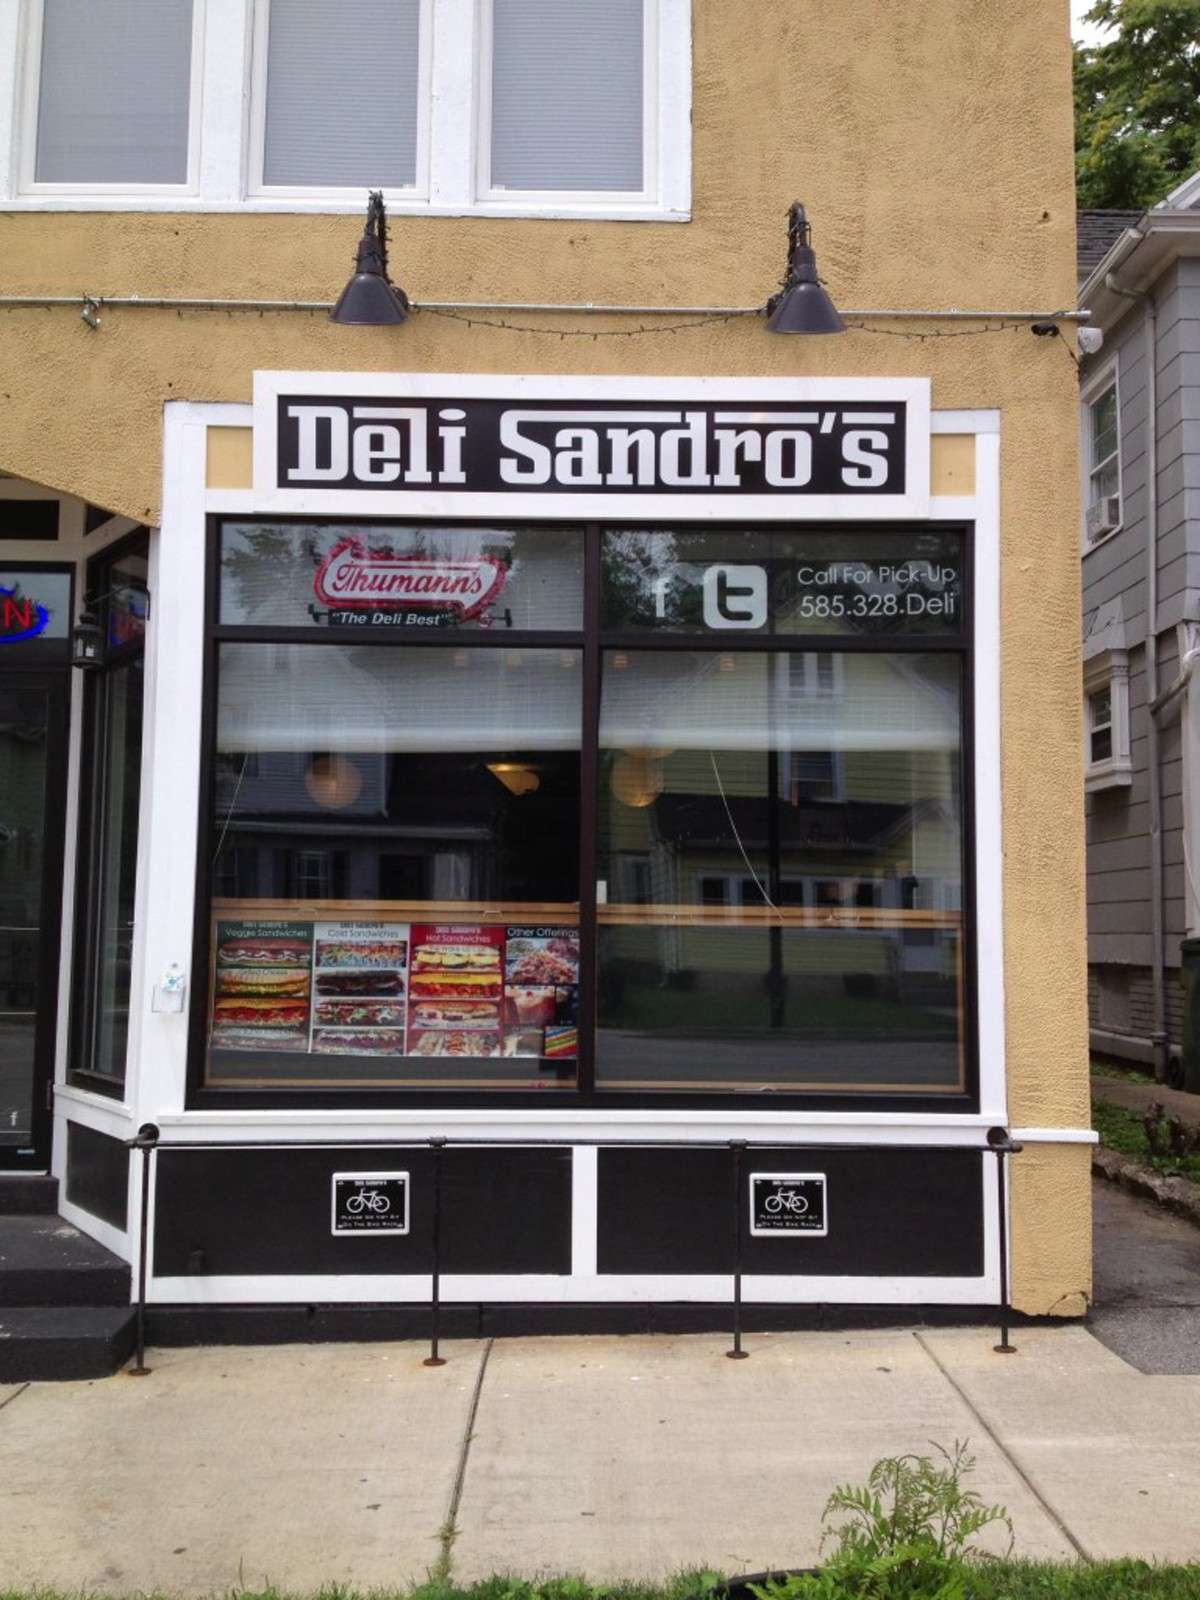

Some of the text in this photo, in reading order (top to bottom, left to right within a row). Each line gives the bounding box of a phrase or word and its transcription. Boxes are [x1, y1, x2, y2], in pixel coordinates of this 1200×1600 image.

[287, 404, 897, 488] Deli Sandro's
[332, 563, 483, 594] Thumann's
[797, 565, 956, 585] Call For Pick-Up
[800, 592, 955, 617] 585.328.Deli
[372, 612, 401, 625] Deli
[225, 928, 308, 938] Veggie Sandwiches
[350, 929, 399, 938] Sandwiches
[426, 934, 491, 944] Hot Sandwiches
[507, 927, 580, 939] Other Offerings
